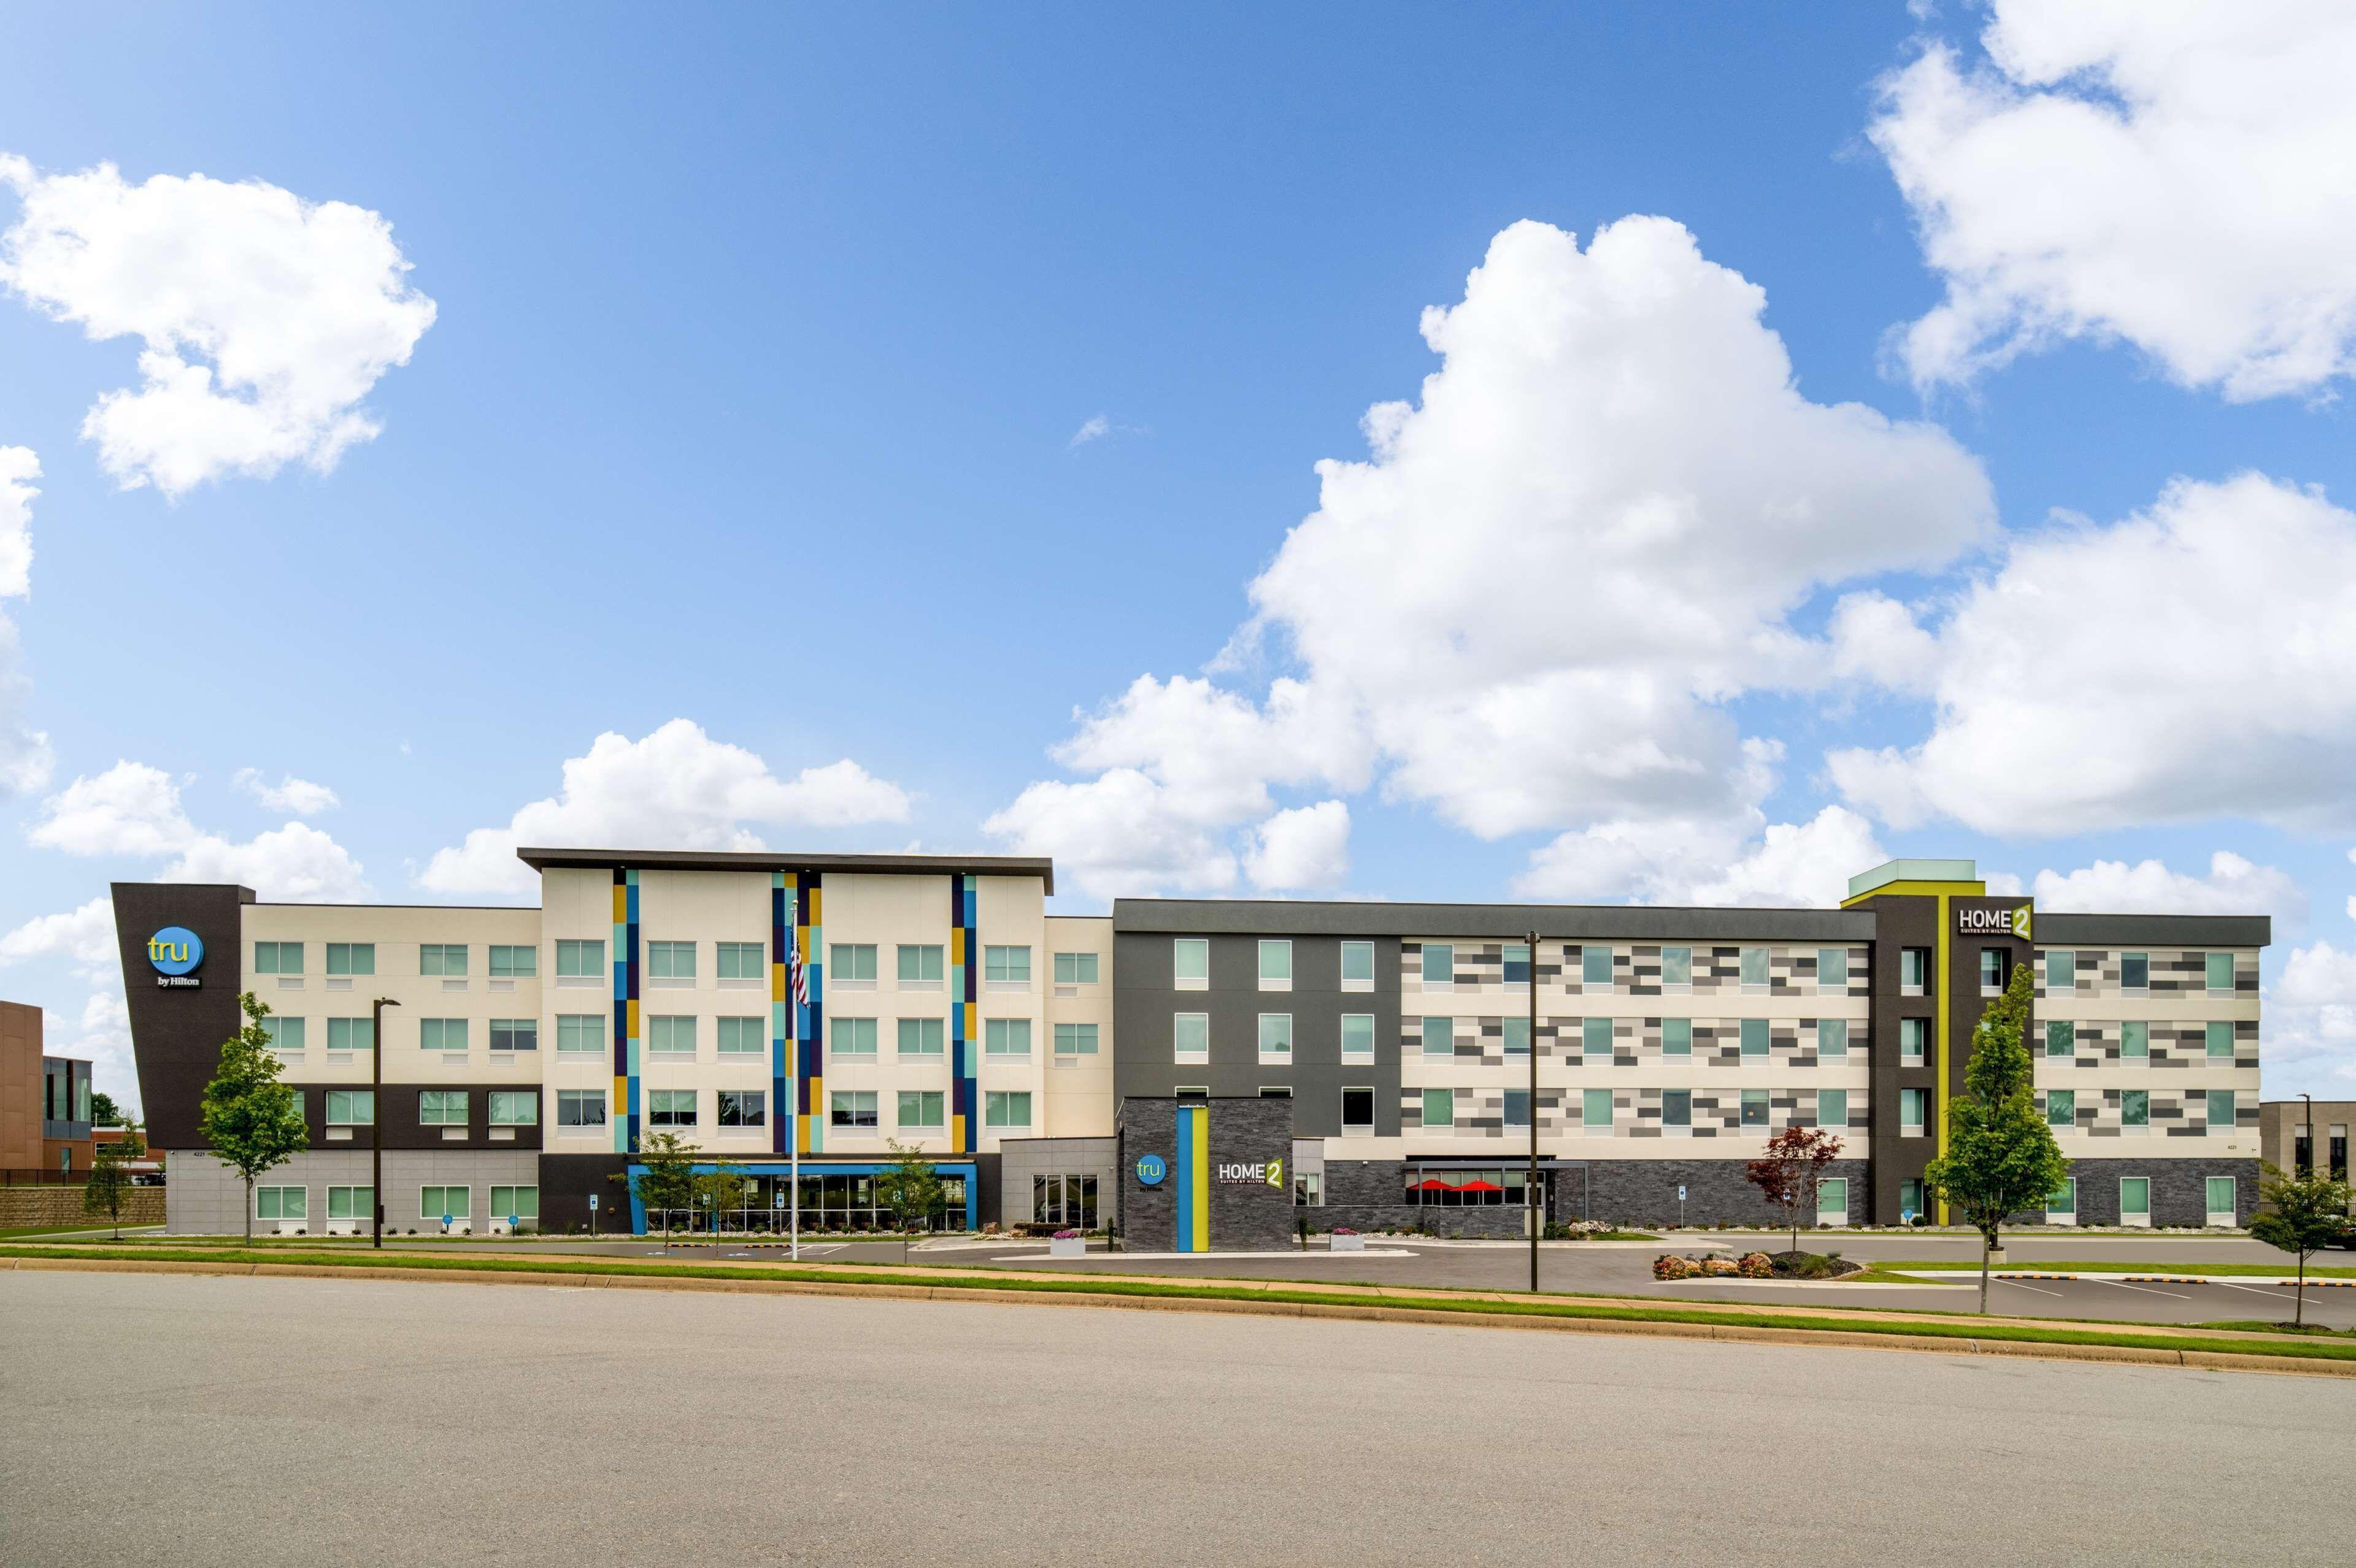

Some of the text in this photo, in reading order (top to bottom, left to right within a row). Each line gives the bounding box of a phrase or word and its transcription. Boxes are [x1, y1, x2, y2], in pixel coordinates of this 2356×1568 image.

[147, 937, 188, 961] tru
[158, 977, 170, 987] by
[1137, 1162, 1159, 1176] tru
